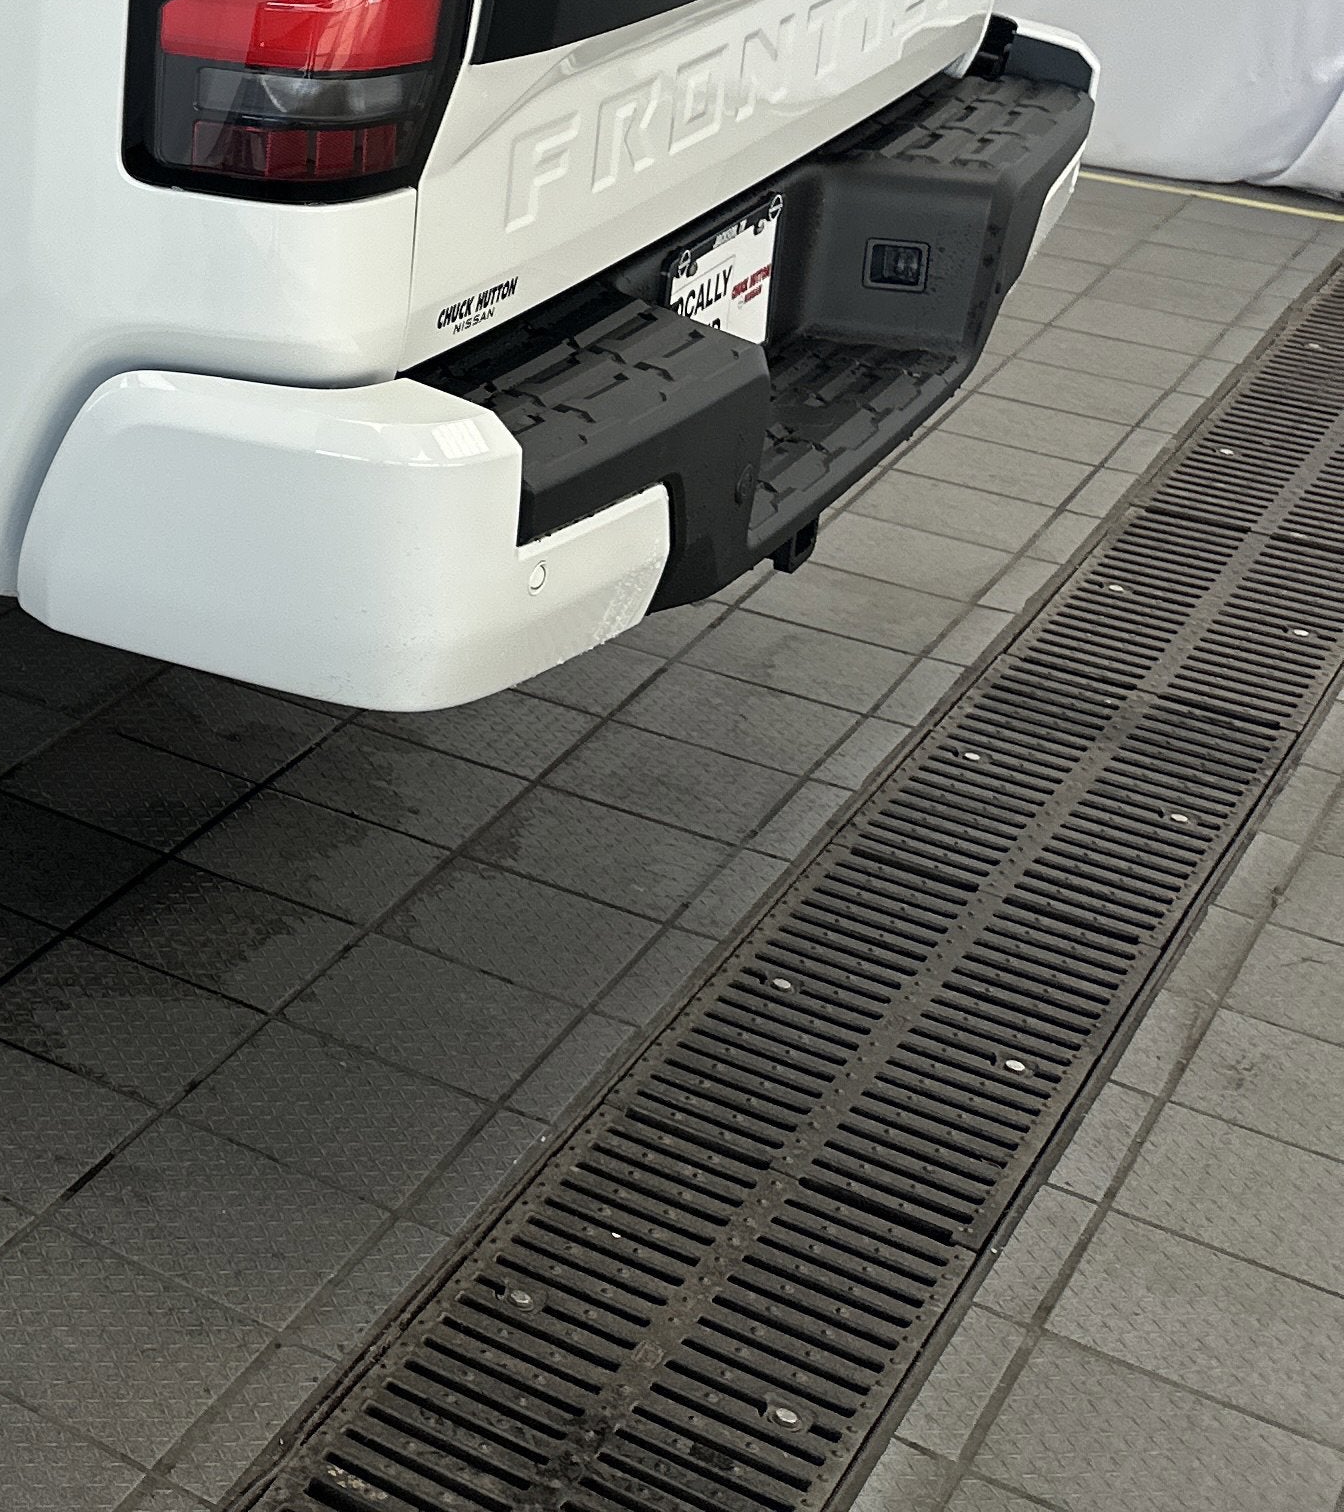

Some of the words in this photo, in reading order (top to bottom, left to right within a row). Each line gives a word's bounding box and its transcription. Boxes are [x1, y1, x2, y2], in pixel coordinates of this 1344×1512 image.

[437, 295, 476, 329] CHUCK
[475, 276, 518, 312] HUTTON
[672, 264, 733, 320] OCALLY
[452, 307, 496, 335] NISSAN
